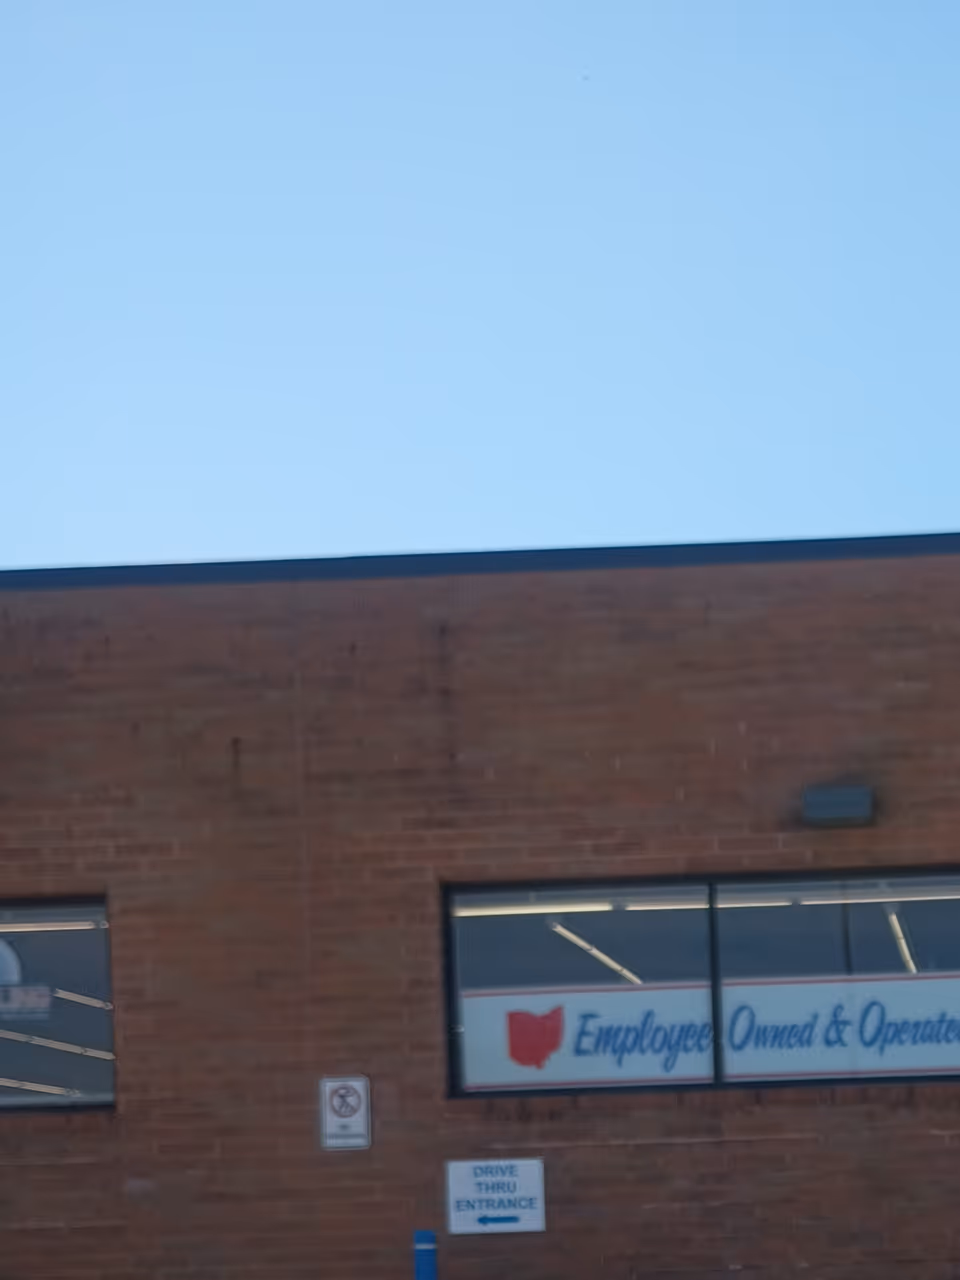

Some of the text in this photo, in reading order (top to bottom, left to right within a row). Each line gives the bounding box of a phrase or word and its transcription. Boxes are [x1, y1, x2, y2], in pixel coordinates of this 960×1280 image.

[574, 1009, 713, 1074] Employee
[728, 1005, 819, 1051] Owned
[824, 1004, 850, 1047] &
[473, 1165, 519, 1178] DRIVE
[475, 1182, 517, 1194] THRU
[456, 1197, 537, 1212] ENTRANCE
